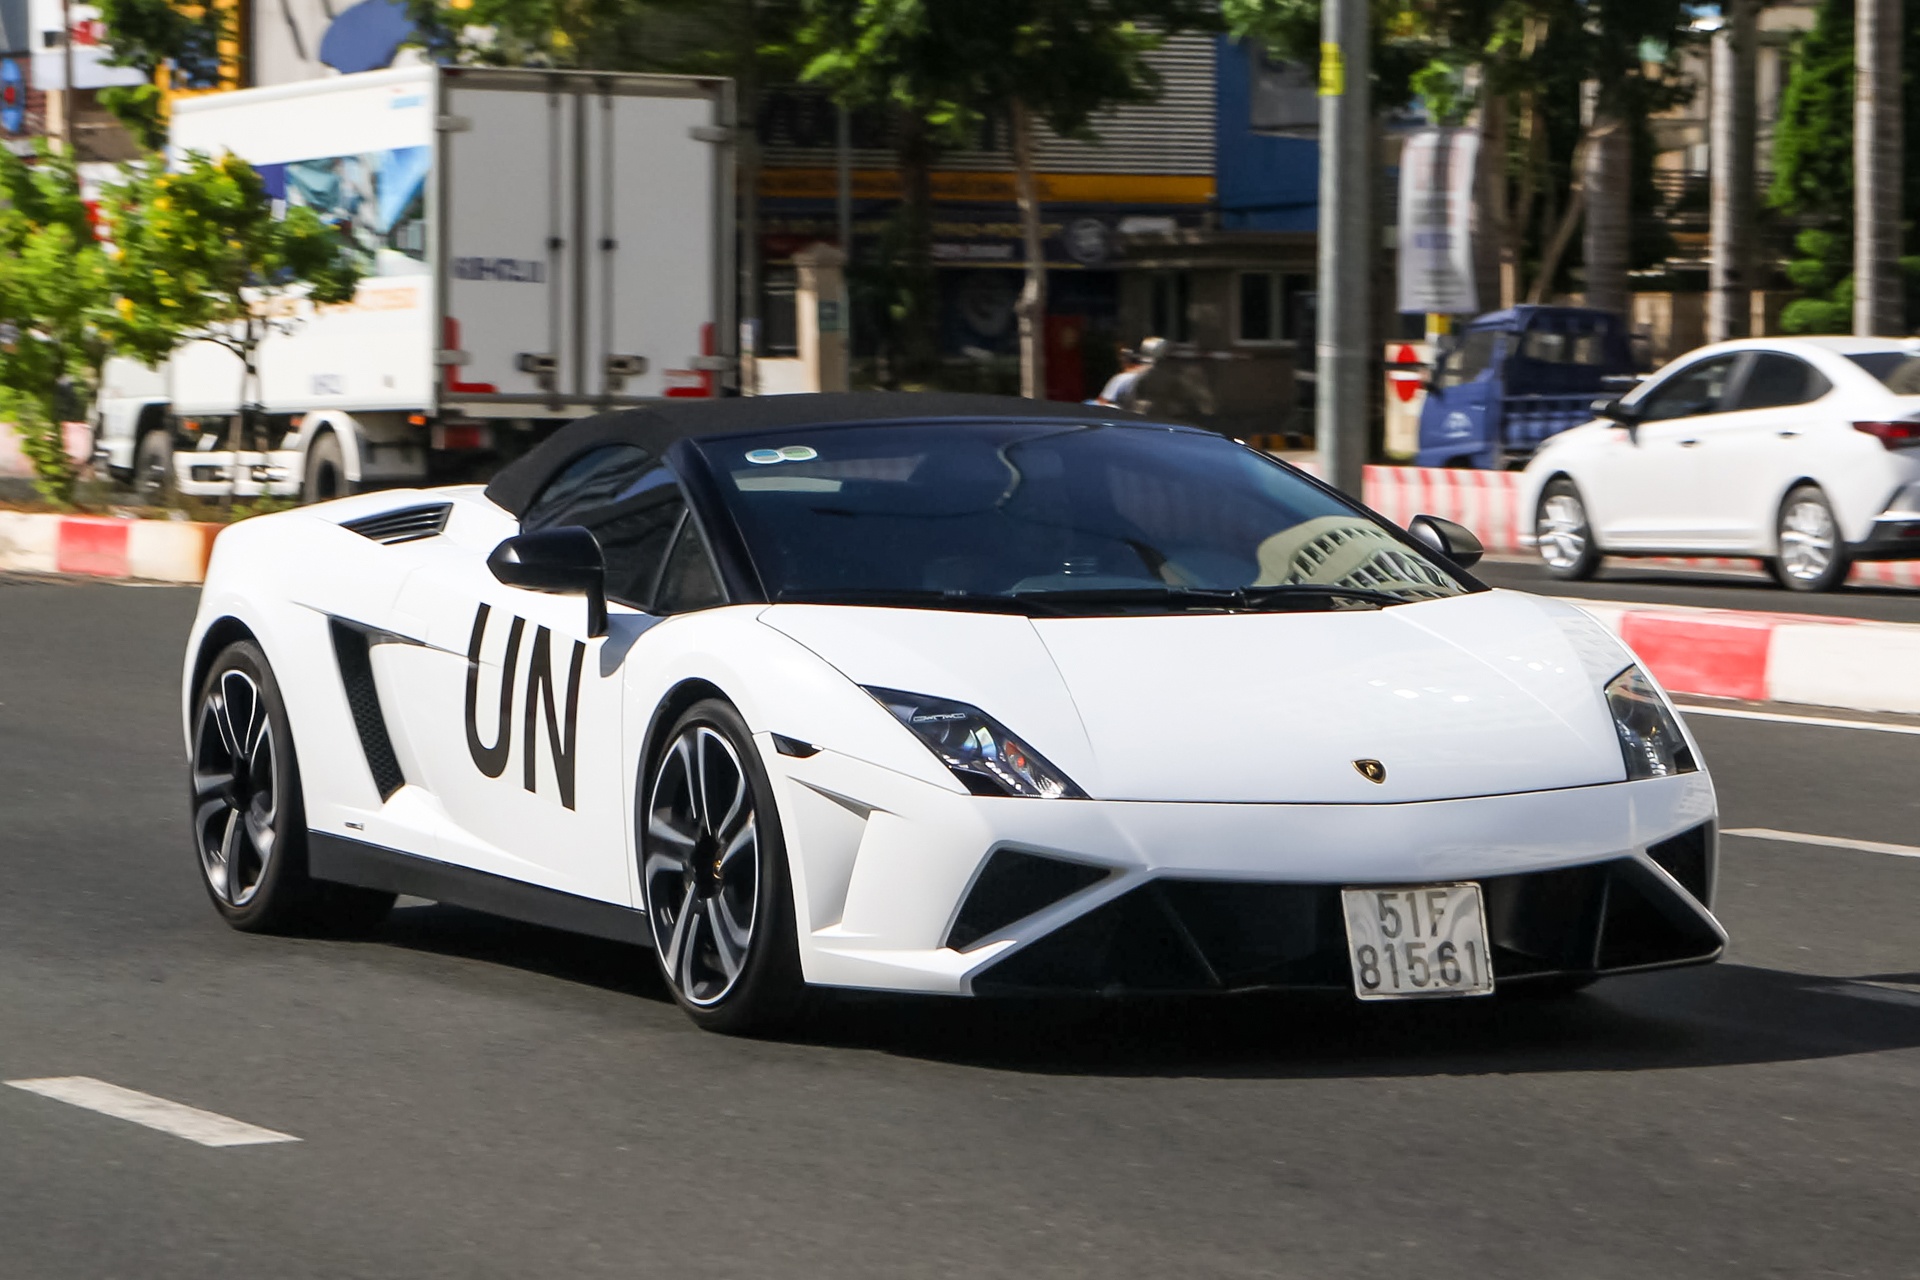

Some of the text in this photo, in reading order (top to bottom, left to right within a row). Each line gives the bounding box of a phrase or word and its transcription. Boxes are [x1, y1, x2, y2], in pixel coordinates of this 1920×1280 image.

[465, 602, 586, 811] UN
[1377, 891, 1447, 938] 51F
[1357, 941, 1480, 989] 815.61
